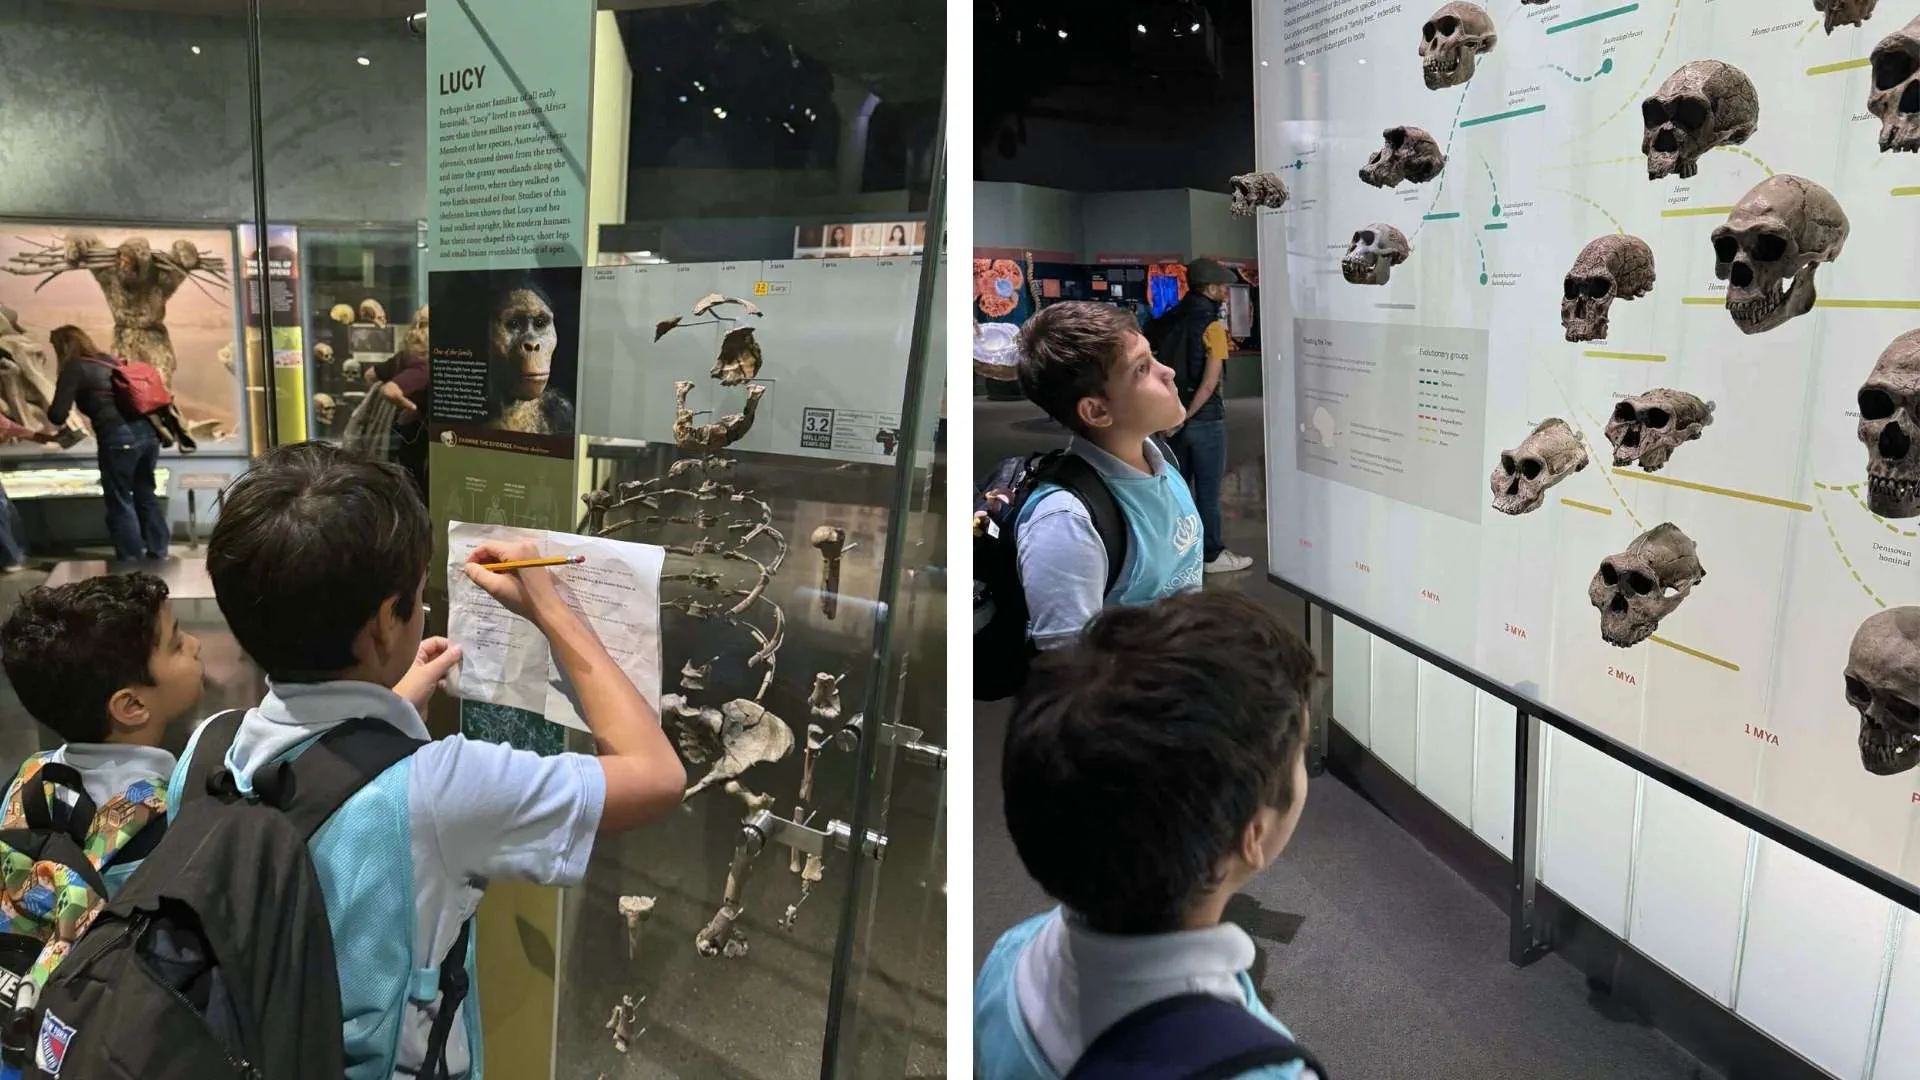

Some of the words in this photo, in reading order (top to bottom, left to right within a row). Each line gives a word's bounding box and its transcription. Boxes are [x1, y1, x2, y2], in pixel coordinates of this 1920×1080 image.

[1751, 26, 1770, 37] Homo
[440, 65, 486, 95] LUCY
[440, 104, 463, 117] Perhaps
[464, 102, 474, 112] the
[476, 100, 491, 110] most
[493, 96, 518, 107] familiar
[539, 88, 556, 99] early
[493, 111, 509, 120] lived
[510, 109, 517, 117] in
[518, 106, 543, 117] eastern
[544, 102, 566, 113] Africa
[440, 134, 455, 143] more
[456, 131, 471, 140] than
[471, 129, 488, 138] three
[489, 124, 513, 135] million
[514, 122, 531, 133] years
[440, 145, 467, 155] Members
[468, 144, 476, 152] of
[476, 142, 487, 150] her
[495, 152, 514, 161] down
[515, 149, 532, 159] from
[533, 148, 546, 156] the
[546, 146, 564, 156] trees
[440, 173, 451, 181] and
[451, 171, 464, 180] into
[465, 169, 476, 178] the
[476, 168, 496, 180] grassy
[497, 163, 532, 175] woodlands
[533, 161, 553, 172] along
[554, 159, 566, 168] the
[440, 185, 456, 196] edges
[456, 184, 464, 192] of
[488, 179, 507, 189] where
[508, 178, 523, 188] they
[525, 175, 549, 185] walked
[470, 194, 492, 205] instead
[492, 194, 500, 203] of
[518, 189, 543, 201] Studies
[544, 188, 553, 198] of
[553, 187, 566, 197] this
[465, 208, 480, 217] have
[480, 206, 501, 217] shown
[502, 206, 516, 215] that
[518, 205, 534, 216] Lucy
[535, 203, 548, 213] and
[549, 203, 561, 212] her
[440, 223, 453, 232] kind
[453, 221, 476, 232] walked
[502, 219, 516, 229] like
[516, 217, 542, 228] modern
[440, 237, 450, 246] But
[451, 236, 466, 245] their
[537, 230, 555, 241] short
[556, 229, 570, 241] legs
[440, 249, 451, 258] and
[451, 248, 468, 258] small
[468, 248, 487, 257] brains
[488, 246, 520, 257] resembled
[521, 246, 539, 255] those
[539, 245, 548, 254] of
[1420, 347, 1450, 360] Evolutionary
[1450, 352, 1469, 361] groups
[806, 417, 829, 432] 3.2
[802, 433, 831, 443] MILLION
[1873, 542, 1912, 557] Denisovan
[1879, 554, 1911, 567] hominid
[1421, 589, 1427, 598] 4
[1427, 590, 1440, 602] MYA
[1504, 623, 1509, 632] 3
[1509, 625, 1527, 639] MYA
[1607, 665, 1614, 677] 2
[1615, 669, 1637, 686] MYA
[1744, 723, 1751, 735] 1
[1753, 726, 1780, 747] MYA
